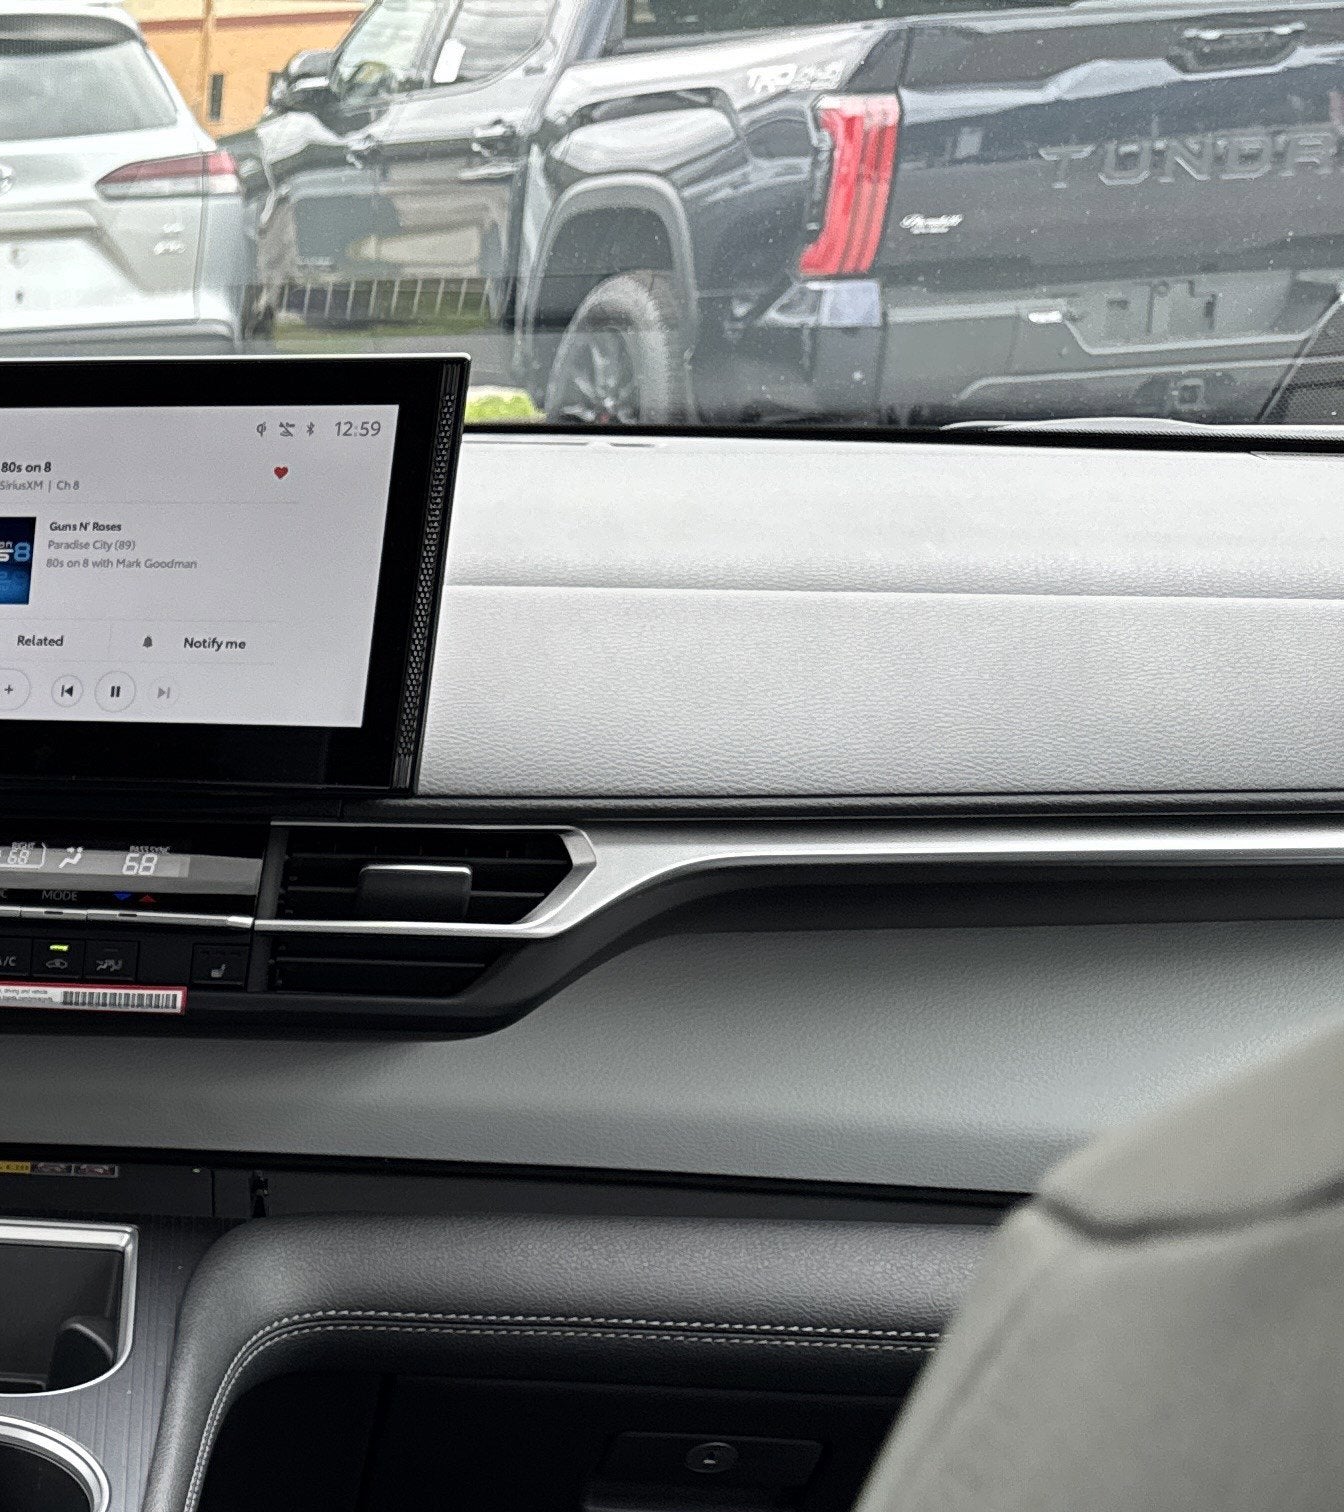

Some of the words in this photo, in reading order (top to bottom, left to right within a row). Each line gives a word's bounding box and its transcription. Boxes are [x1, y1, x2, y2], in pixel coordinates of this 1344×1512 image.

[1039, 122, 1344, 189] TUNDR
[335, 420, 381, 437] 12:59
[0, 462, 22, 473] 80s
[25, 464, 41, 473] on
[43, 461, 52, 473] 8
[0, 480, 43, 491] SiriusXM
[56, 480, 70, 491] Ch
[73, 480, 80, 491] 8
[49, 522, 77, 532] Guns
[92, 522, 122, 532] Roses
[48, 540, 90, 551] Paradise
[92, 540, 113, 552] City
[114, 539, 137, 551] (89)
[46, 558, 64, 569] 80s
[67, 560, 81, 568] on
[83, 558, 89, 568] 8
[91, 558, 114, 569] with
[116, 558, 141, 569] Mark
[144, 559, 197, 570] Goodman
[16, 635, 64, 647] Related
[183, 637, 223, 652] Notify
[225, 639, 246, 650] me
[122, 853, 158, 875] 68
[41, 890, 78, 901] MODE
